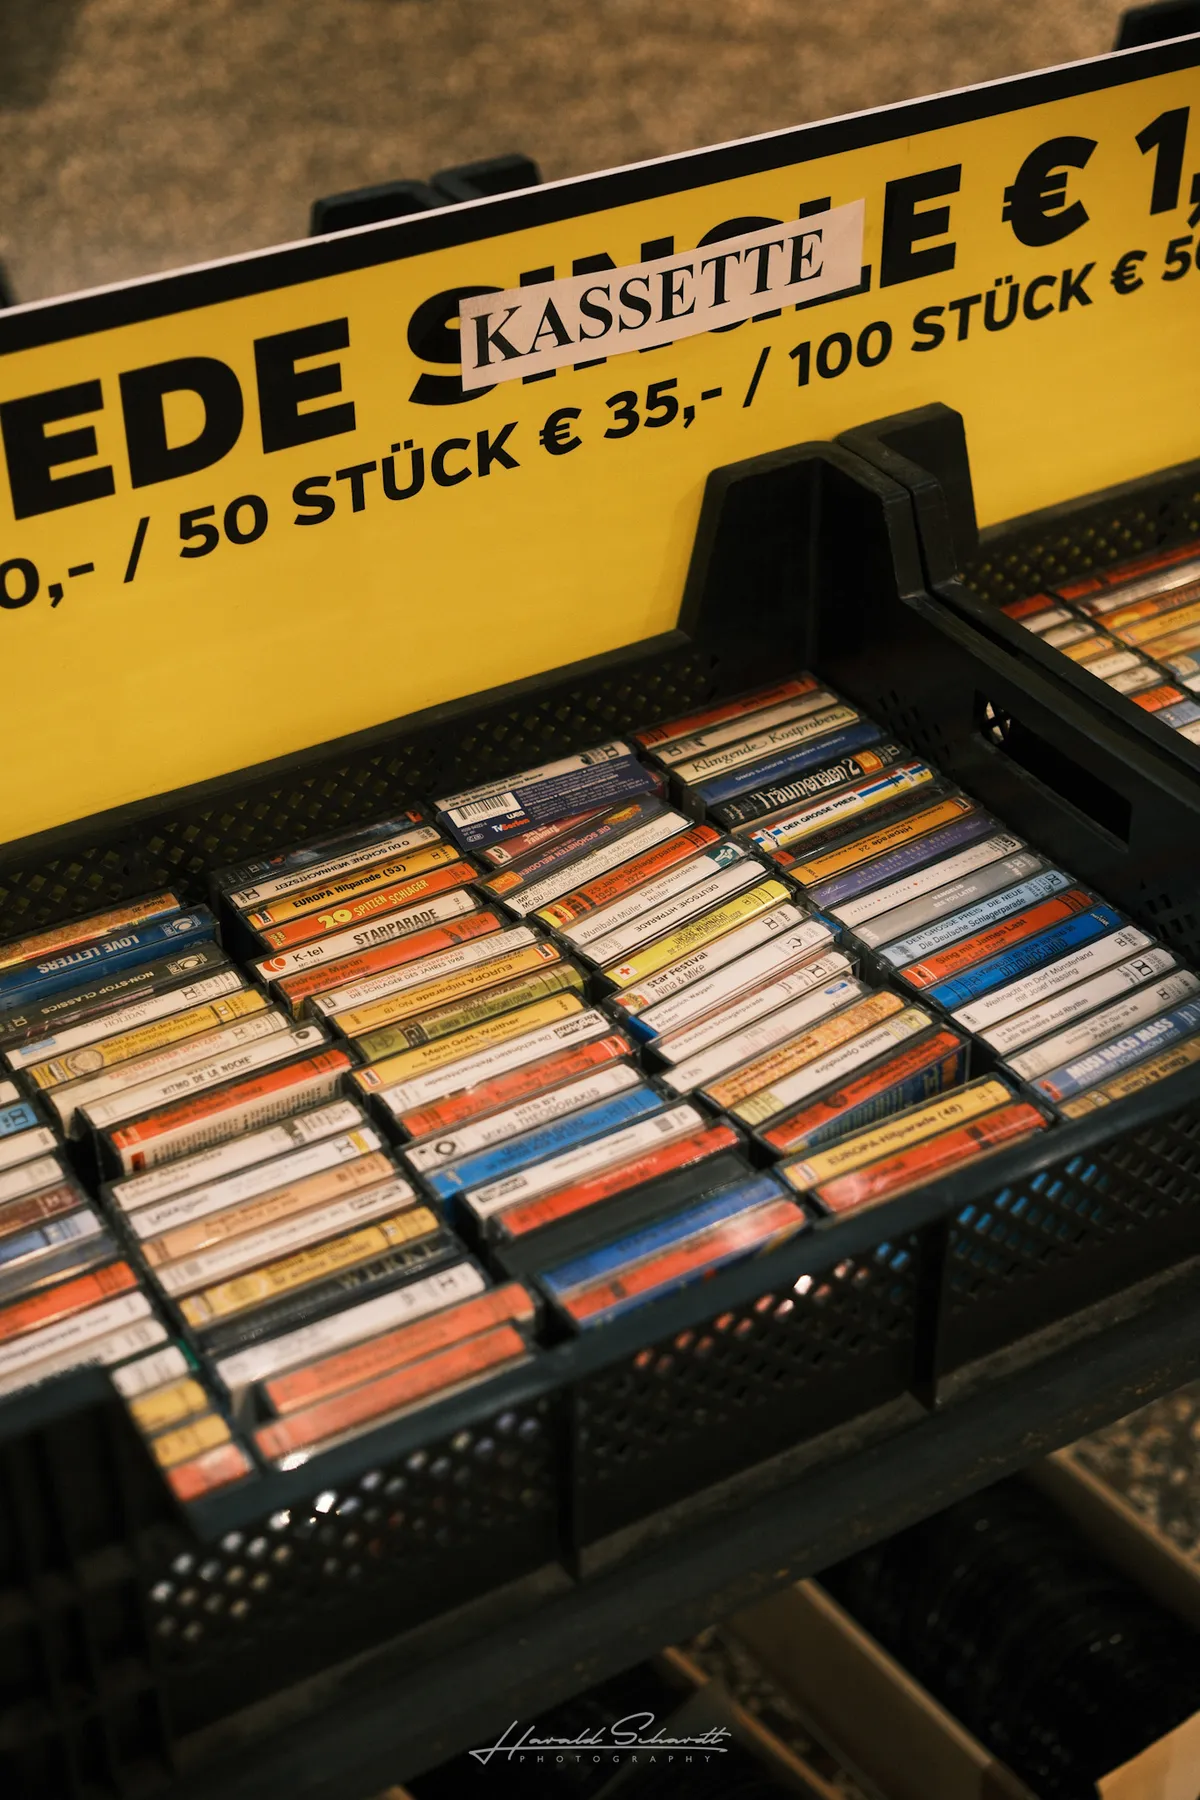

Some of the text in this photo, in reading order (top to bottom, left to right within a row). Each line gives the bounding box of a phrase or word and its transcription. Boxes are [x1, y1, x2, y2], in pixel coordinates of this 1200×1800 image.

[1002, 136, 1098, 247] €
[471, 229, 825, 370] KASSETTE
[123, 517, 150, 583] /
[179, 494, 268, 558] 50
[293, 421, 520, 525] STÜCK
[539, 407, 583, 458] €
[603, 378, 724, 443] 35,-
[742, 347, 771, 408] /
[788, 321, 893, 387] 100
[911, 261, 1096, 352] STÜCK
[1110, 250, 1147, 295] €
[1162, 234, 1200, 281] 5
[692, 740, 768, 774] Klingende
[757, 758, 860, 809] Träumereien 2
[596, 823, 610, 834] DIE
[782, 796, 857, 832] DER GROSSE PREIS
[350, 846, 387, 865] SCHÖNE
[387, 841, 401, 851] DU
[552, 830, 599, 858] SCHÖNSTEN
[857, 823, 912, 853] Hitparade 24
[273, 859, 350, 892] WEIHNACHTSZEIT
[516, 852, 555, 877] MELODIEN
[588, 840, 686, 896] 25 Jahre Schlagerparade
[640, 864, 698, 898] Der verwundete
[292, 890, 334, 908] EUROPA
[335, 871, 382, 893] Hitparade
[383, 864, 407, 880] (53)
[516, 894, 530, 904] IMP
[595, 871, 647, 900] 1950 1975
[676, 882, 719, 909] DEUTSCHE
[317, 880, 430, 930] 20 SPITZEN SCHLAGER
[521, 899, 534, 909] MC
[581, 915, 615, 940] Wunibald
[616, 903, 643, 921] Müller
[632, 905, 678, 933] HITPARADE
[905, 887, 1024, 946] DER GROSSE PREIS DIE NEUE
[353, 907, 439, 946] STARPARADE
[918, 897, 1026, 951] Die Deutsche Schlagerparade
[36, 931, 140, 977] LOVE LETTERS
[292, 947, 324, 963] K-tel
[936, 919, 1027, 966] Sing mit James Last
[283, 969, 327, 990] Andreas
[328, 955, 363, 974] Martin
[349, 961, 447, 1000] DIE SCHLAGER DES JAHRES
[466, 962, 512, 984] EUROPA
[646, 951, 709, 989] Star Festival
[655, 963, 707, 998] Nina & Mike
[984, 950, 1093, 1009] Weihnacht im Dorf Münsterland
[1015, 967, 1079, 1003] mit Josef Hassing
[39, 968, 154, 1016] NON-STOP CLASSICS
[415, 979, 466, 1003] hitparade
[103, 1008, 148, 1028] HOLIDAY
[656, 1012, 679, 1028] Advent
[1002, 1030, 1020, 1044] Latin
[1049, 1009, 1063, 1020] And
[1062, 996, 1089, 1014] Rhythm
[1133, 1014, 1174, 1044] MASS
[422, 1042, 450, 1057] Mein
[479, 1016, 520, 1036] Walther
[191, 1068, 219, 1084] DE LA
[513, 1094, 557, 1117] HITS BY
[517, 1086, 601, 1127] THEODORAKIS
